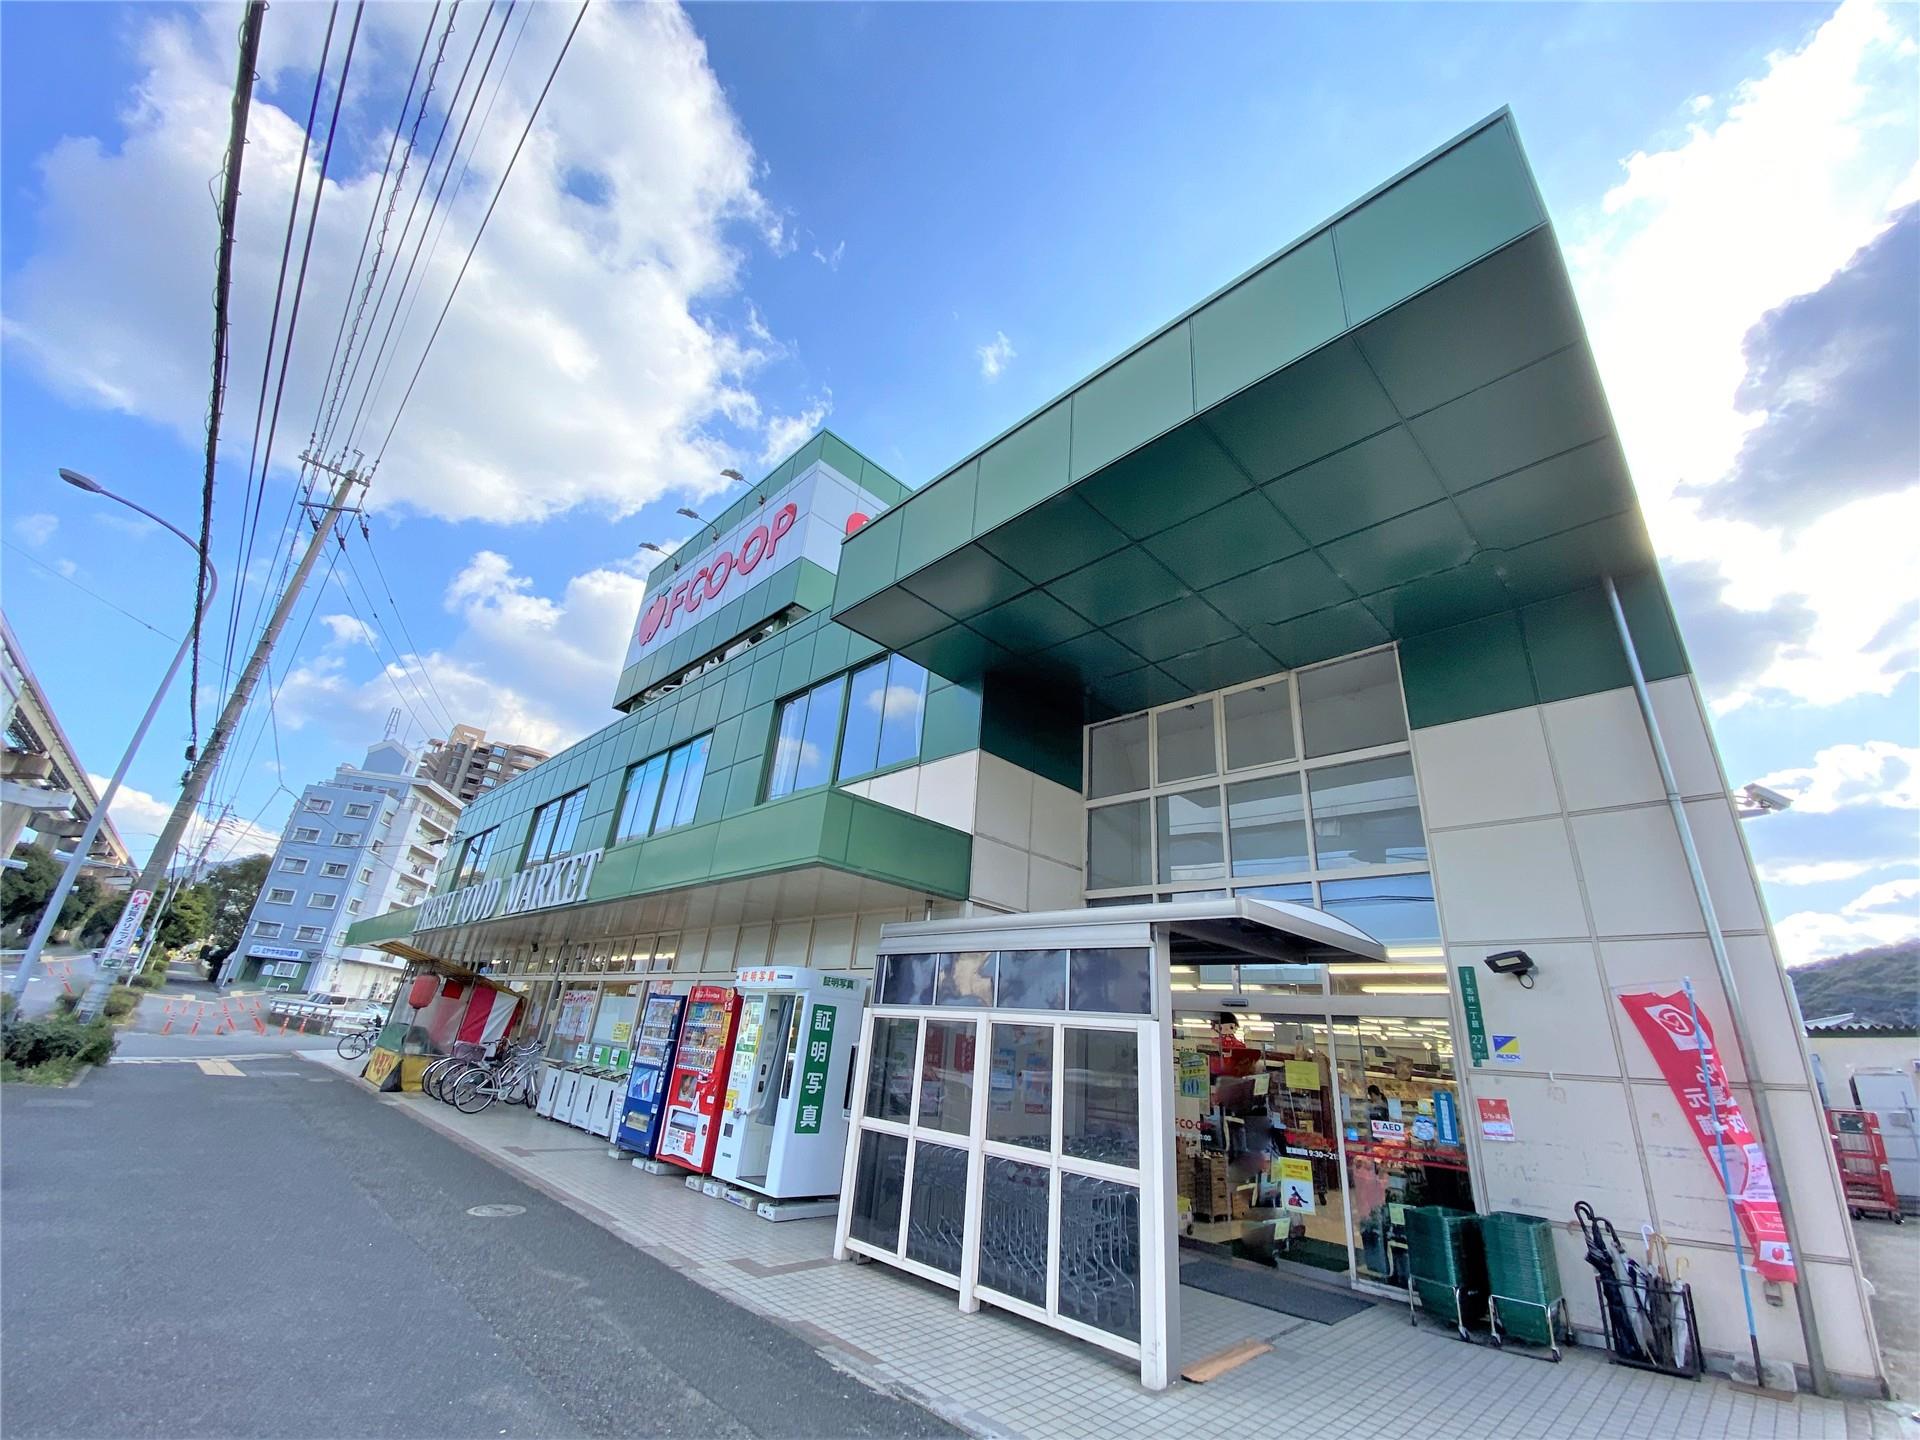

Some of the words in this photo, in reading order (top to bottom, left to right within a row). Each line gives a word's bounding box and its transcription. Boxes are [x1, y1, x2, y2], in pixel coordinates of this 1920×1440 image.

[413, 890, 458, 932] FRESH
[453, 877, 503, 925] FOOD
[501, 847, 606, 916] MARKET
[741, 970, 776, 982] 証明写真
[823, 976, 854, 990] 証明写真
[1471, 1034, 1484, 1044] 27
[800, 1009, 832, 1128] 証明写真
[1382, 1123, 1402, 1132] AED
